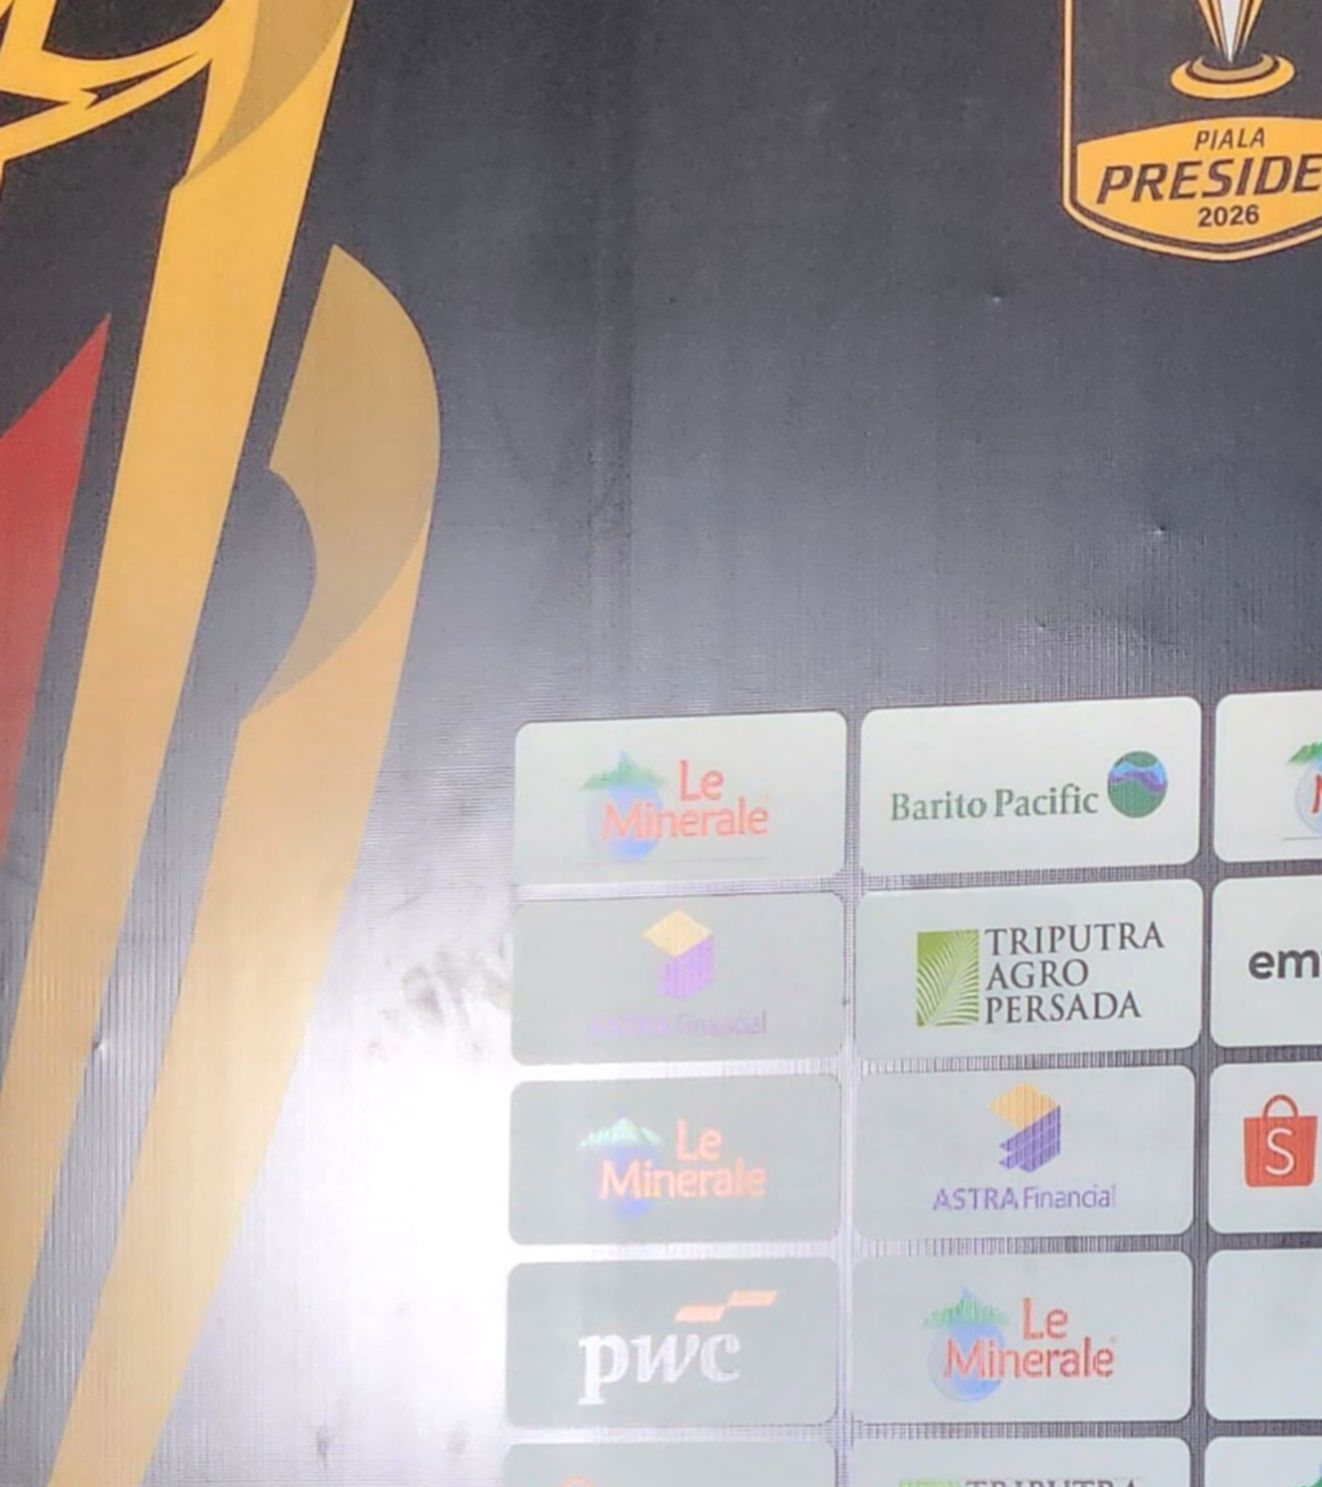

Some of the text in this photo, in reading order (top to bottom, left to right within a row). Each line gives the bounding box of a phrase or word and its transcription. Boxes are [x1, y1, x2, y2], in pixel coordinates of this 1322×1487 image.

[1194, 127, 1265, 150] PIALA
[1197, 205, 1260, 227] 2026
[678, 760, 724, 801] Le
[602, 798, 770, 840] Minerale
[890, 788, 1100, 822] Barito Pacific
[985, 921, 1165, 958] TRIPUTRA
[986, 959, 1090, 990] AGRO
[985, 992, 1141, 1026] PERSADA
[675, 1121, 722, 1161] Le
[599, 1158, 767, 1202] Minerale
[932, 1184, 1115, 1211] ASTRA Financial
[1023, 1297, 1068, 1341] Le
[578, 1332, 741, 1405] pwc
[943, 1338, 1115, 1380] Minerale
